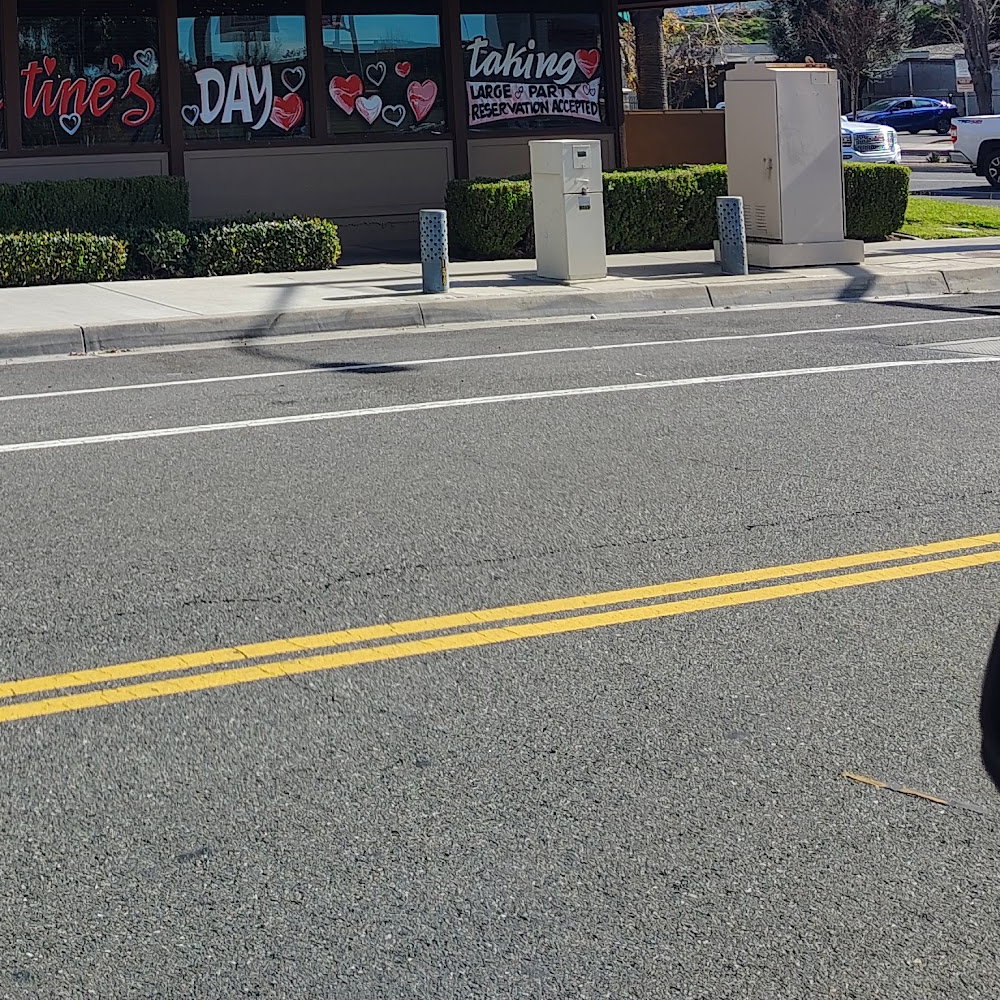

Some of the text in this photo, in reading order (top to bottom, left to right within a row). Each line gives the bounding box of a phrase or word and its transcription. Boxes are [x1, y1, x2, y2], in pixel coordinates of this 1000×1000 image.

[466, 36, 577, 85] taking
[194, 63, 274, 131] DAY
[470, 84, 581, 99] LARGE PARTY
[471, 99, 598, 121] RESERVATION ACCEPTED
